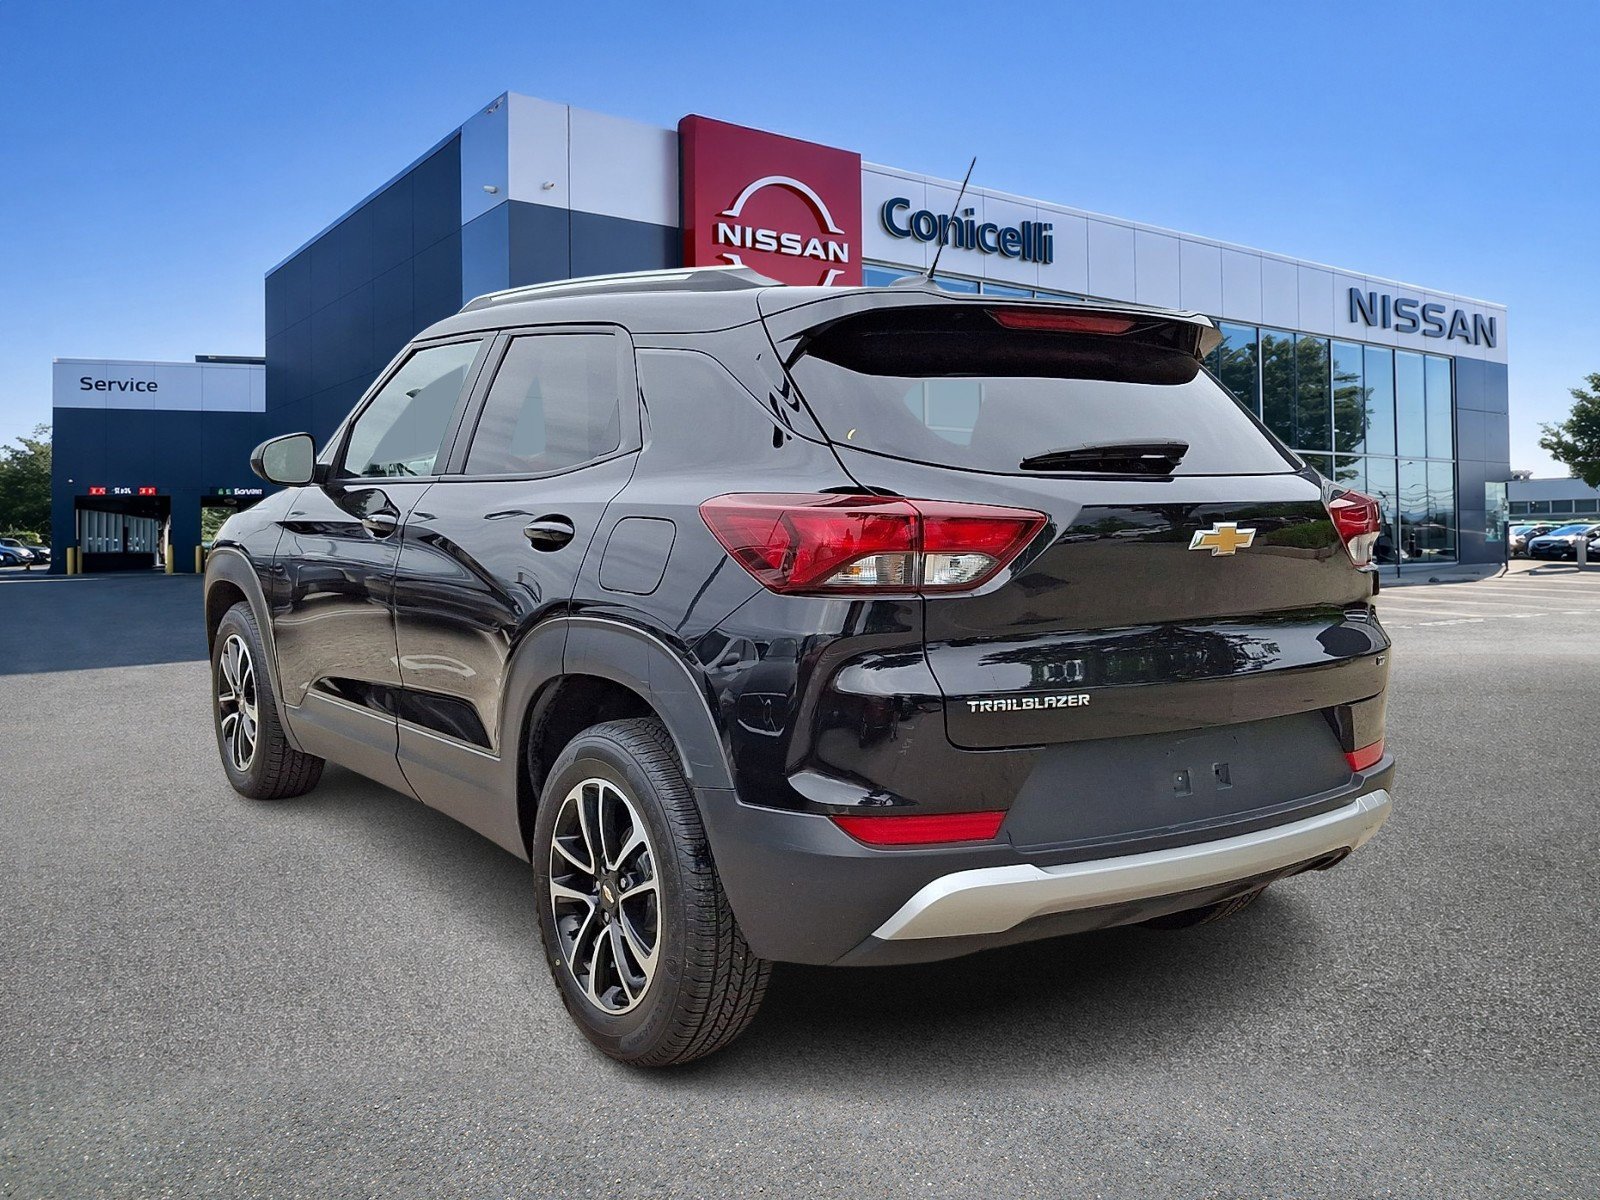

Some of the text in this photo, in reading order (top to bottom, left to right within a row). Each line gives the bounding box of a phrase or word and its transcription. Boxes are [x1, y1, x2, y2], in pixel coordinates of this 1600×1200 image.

[716, 222, 849, 263] NISSAN
[882, 197, 1053, 265] Conicelli
[1349, 287, 1497, 348] NISSAN
[80, 376, 158, 393] Service
[966, 693, 1091, 713] TRAILBLAZER
